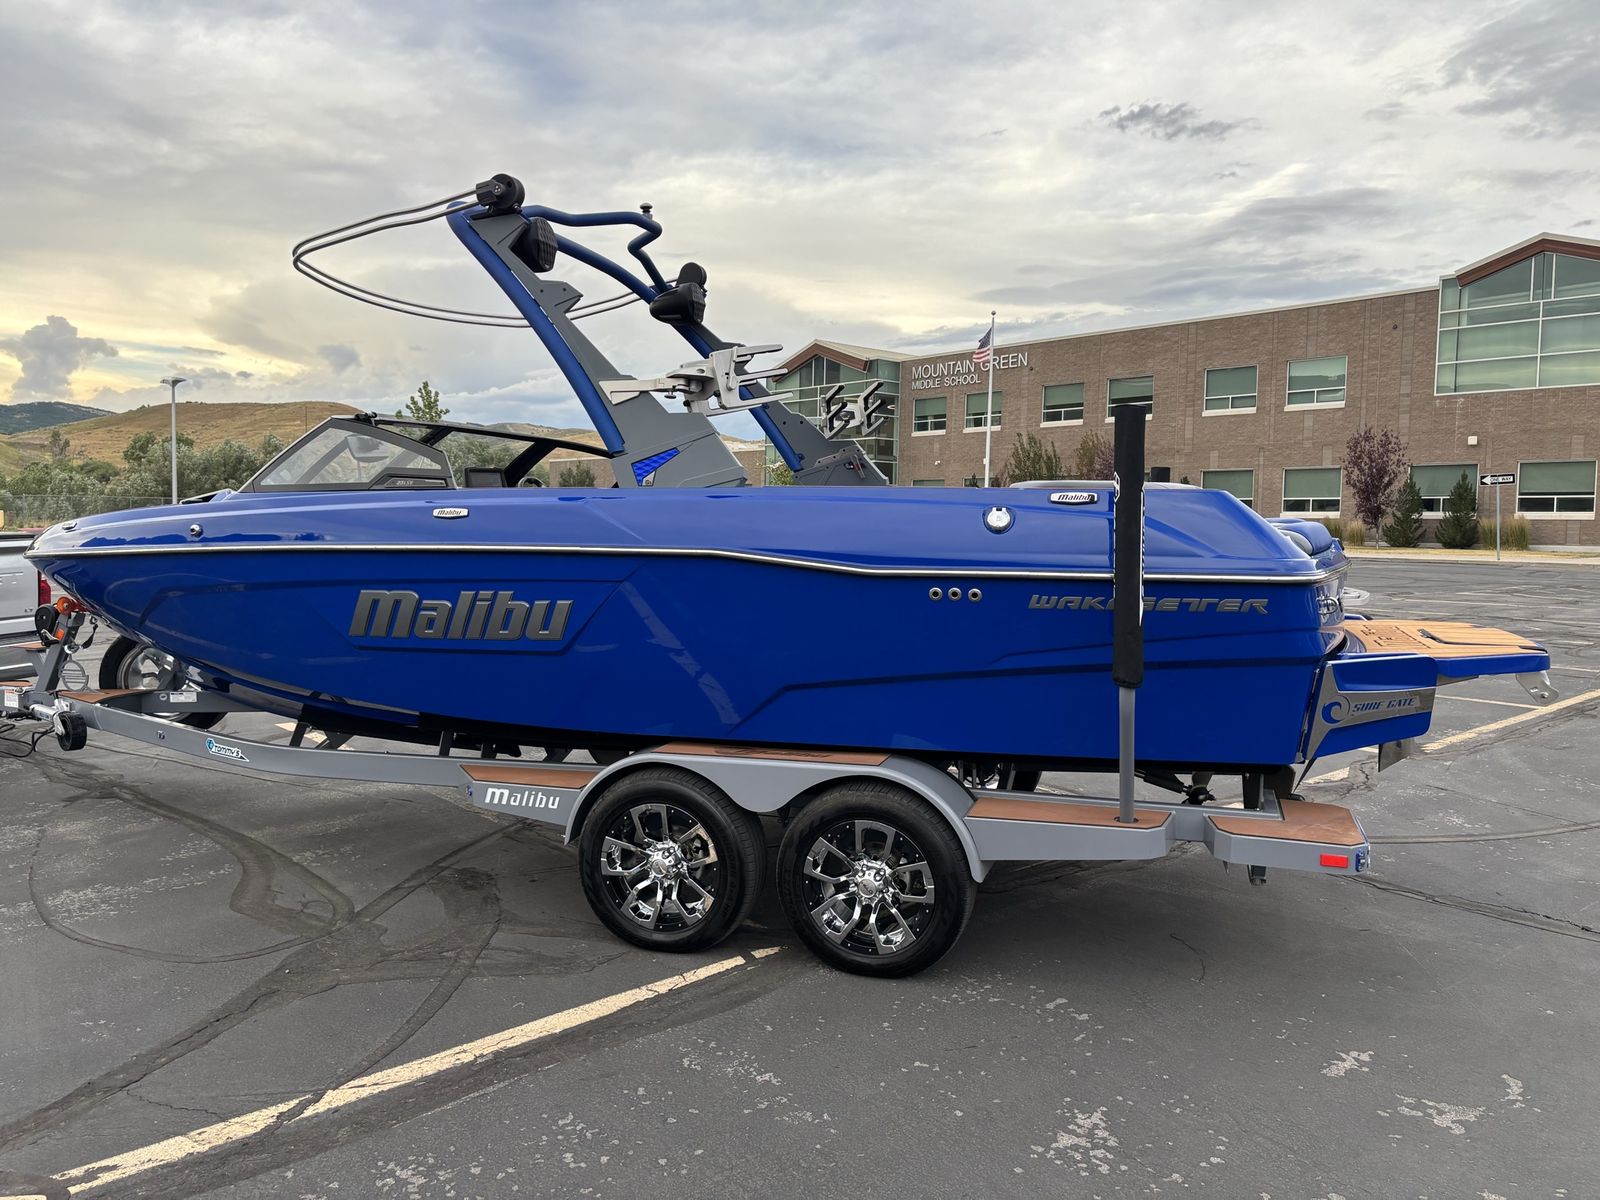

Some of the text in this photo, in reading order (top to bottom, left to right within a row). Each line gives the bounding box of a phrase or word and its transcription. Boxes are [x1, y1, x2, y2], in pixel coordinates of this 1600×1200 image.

[911, 352, 1028, 380] MOUNTAIN GREEN
[911, 373, 981, 391] MIDDLE SCHOOL
[348, 589, 574, 641] Malibu
[1352, 697, 1415, 712] SURF GATE
